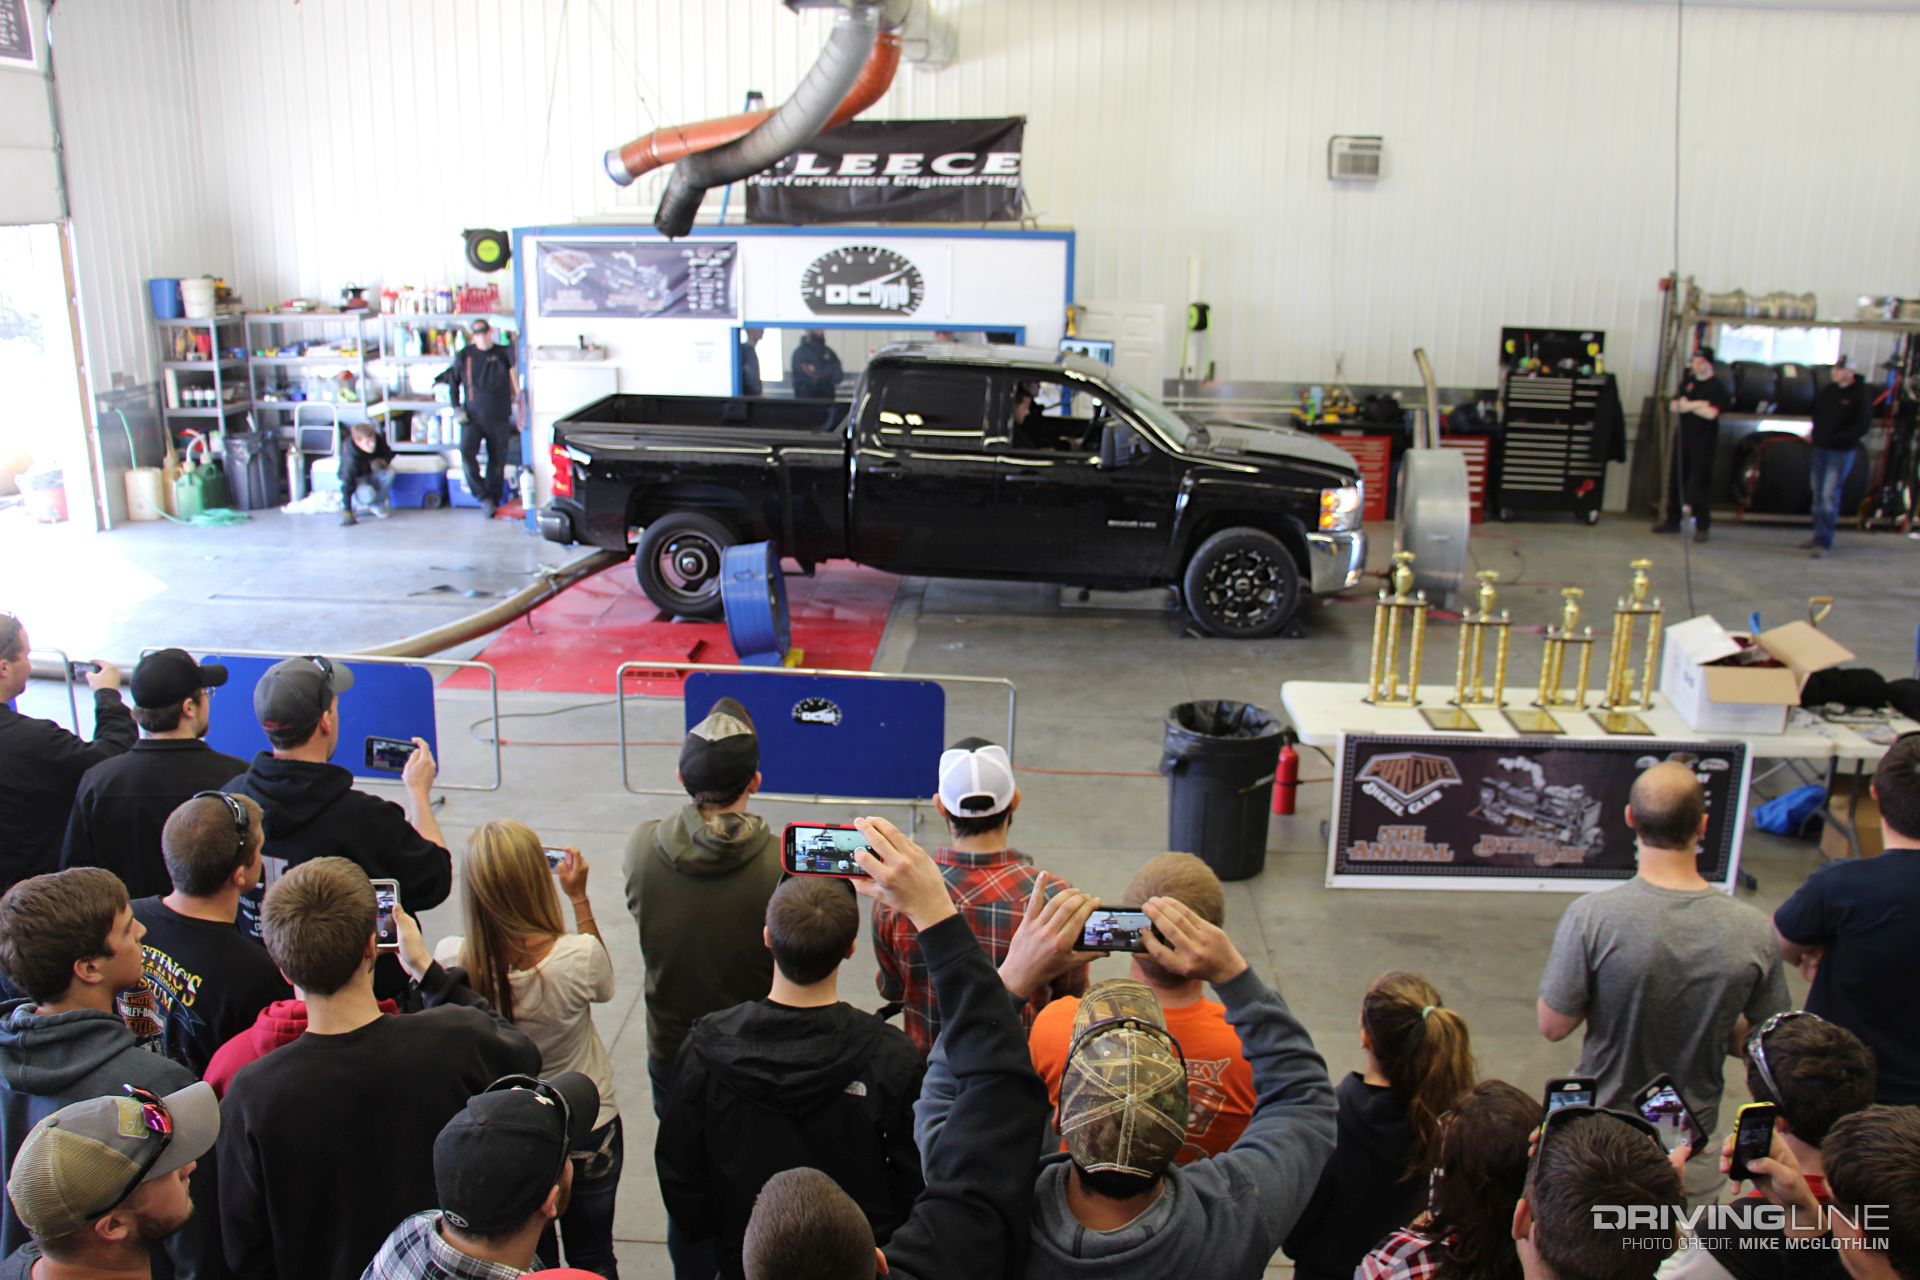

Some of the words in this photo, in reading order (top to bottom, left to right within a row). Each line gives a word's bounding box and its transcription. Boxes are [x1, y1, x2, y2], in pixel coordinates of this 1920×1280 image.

[763, 152, 1021, 176] LEECE
[747, 174, 889, 188] Performance
[892, 174, 1020, 189] Engineering
[1362, 757, 1459, 796] PURDUE
[1346, 840, 1455, 862] ANNUAL
